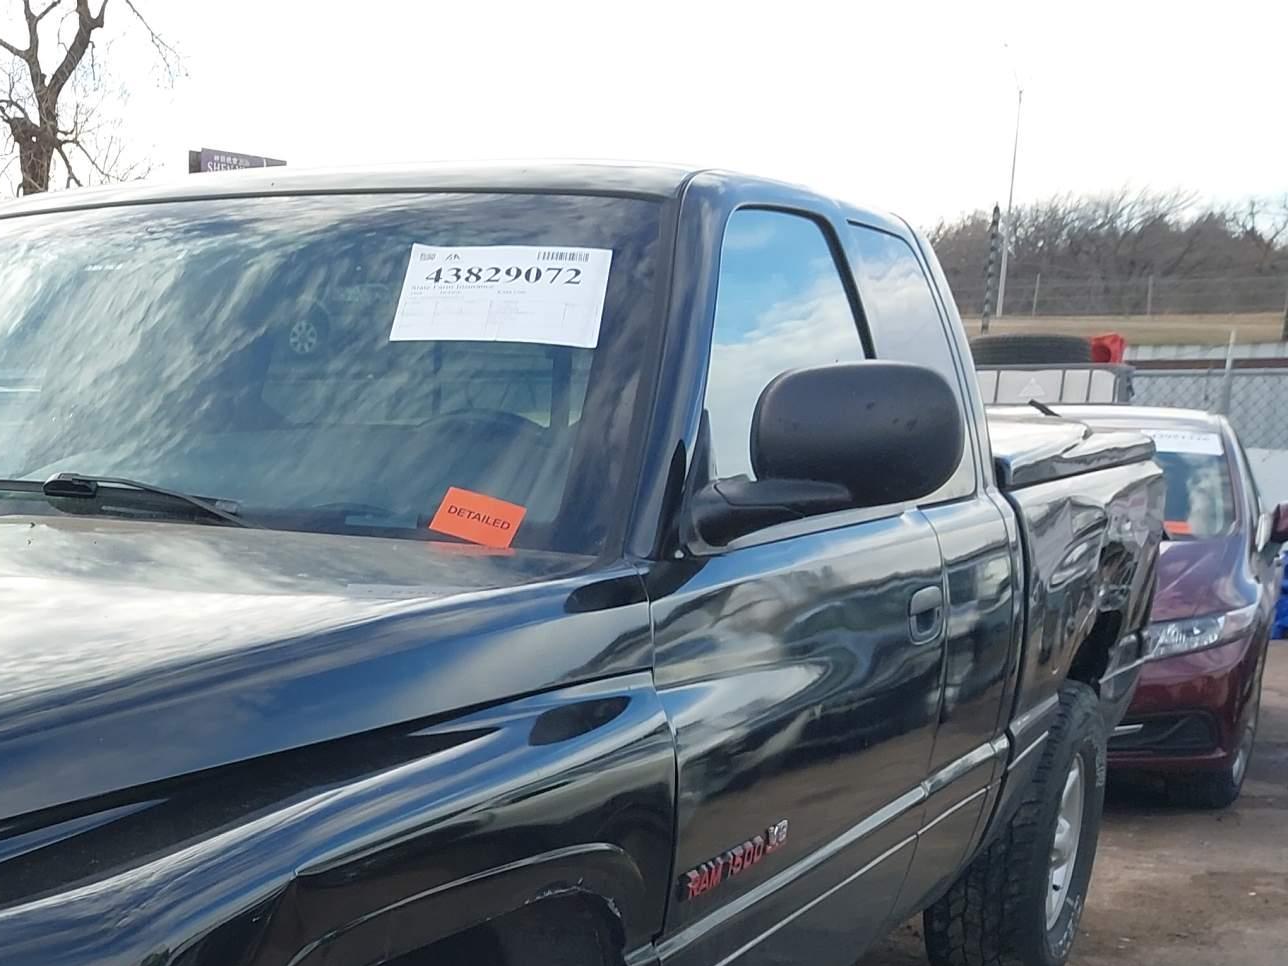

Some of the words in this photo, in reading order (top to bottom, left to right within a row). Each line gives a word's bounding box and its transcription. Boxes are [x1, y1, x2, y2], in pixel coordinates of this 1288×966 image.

[424, 266, 582, 285] 43829072
[447, 504, 511, 531] DETAILED
[686, 858, 724, 900] RAM
[727, 834, 764, 880] 1500
